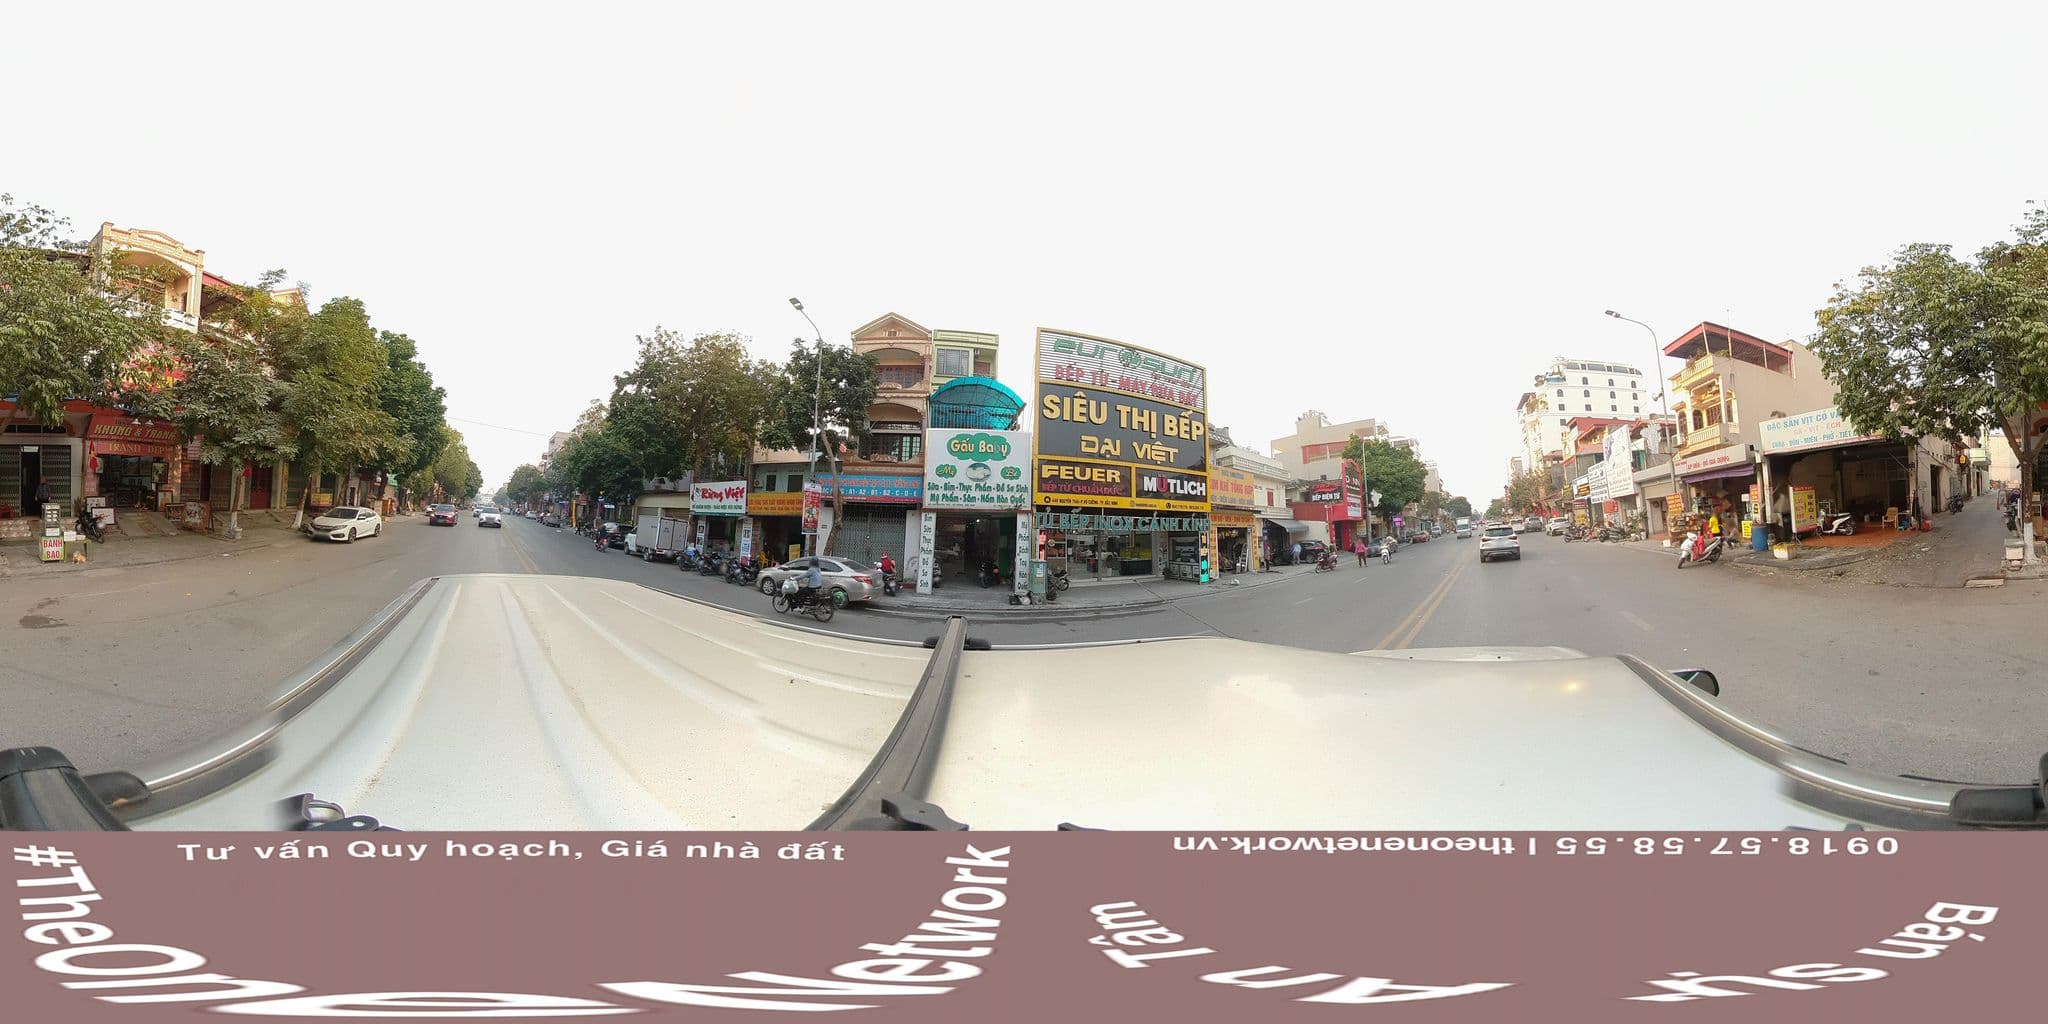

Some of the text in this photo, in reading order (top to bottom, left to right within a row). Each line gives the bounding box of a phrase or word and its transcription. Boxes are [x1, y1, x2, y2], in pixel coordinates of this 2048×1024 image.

[1055, 362, 1085, 382] BẾP
[1043, 391, 1204, 441] SIÊU THỊ BẾP
[1783, 417, 1799, 428] SẢN
[1801, 415, 1813, 425] VỊT
[94, 424, 132, 436] KHUNG
[951, 437, 974, 453] Gấu
[1132, 440, 1178, 464] VIỆT
[1041, 464, 1121, 483] FEUER
[701, 486, 745, 503] Rừng Việt
[1143, 474, 1206, 496] MÜTLICH
[1060, 509, 1090, 530] BẾP
[1093, 514, 1133, 531] INOX
[46, 550, 60, 559] BAO
